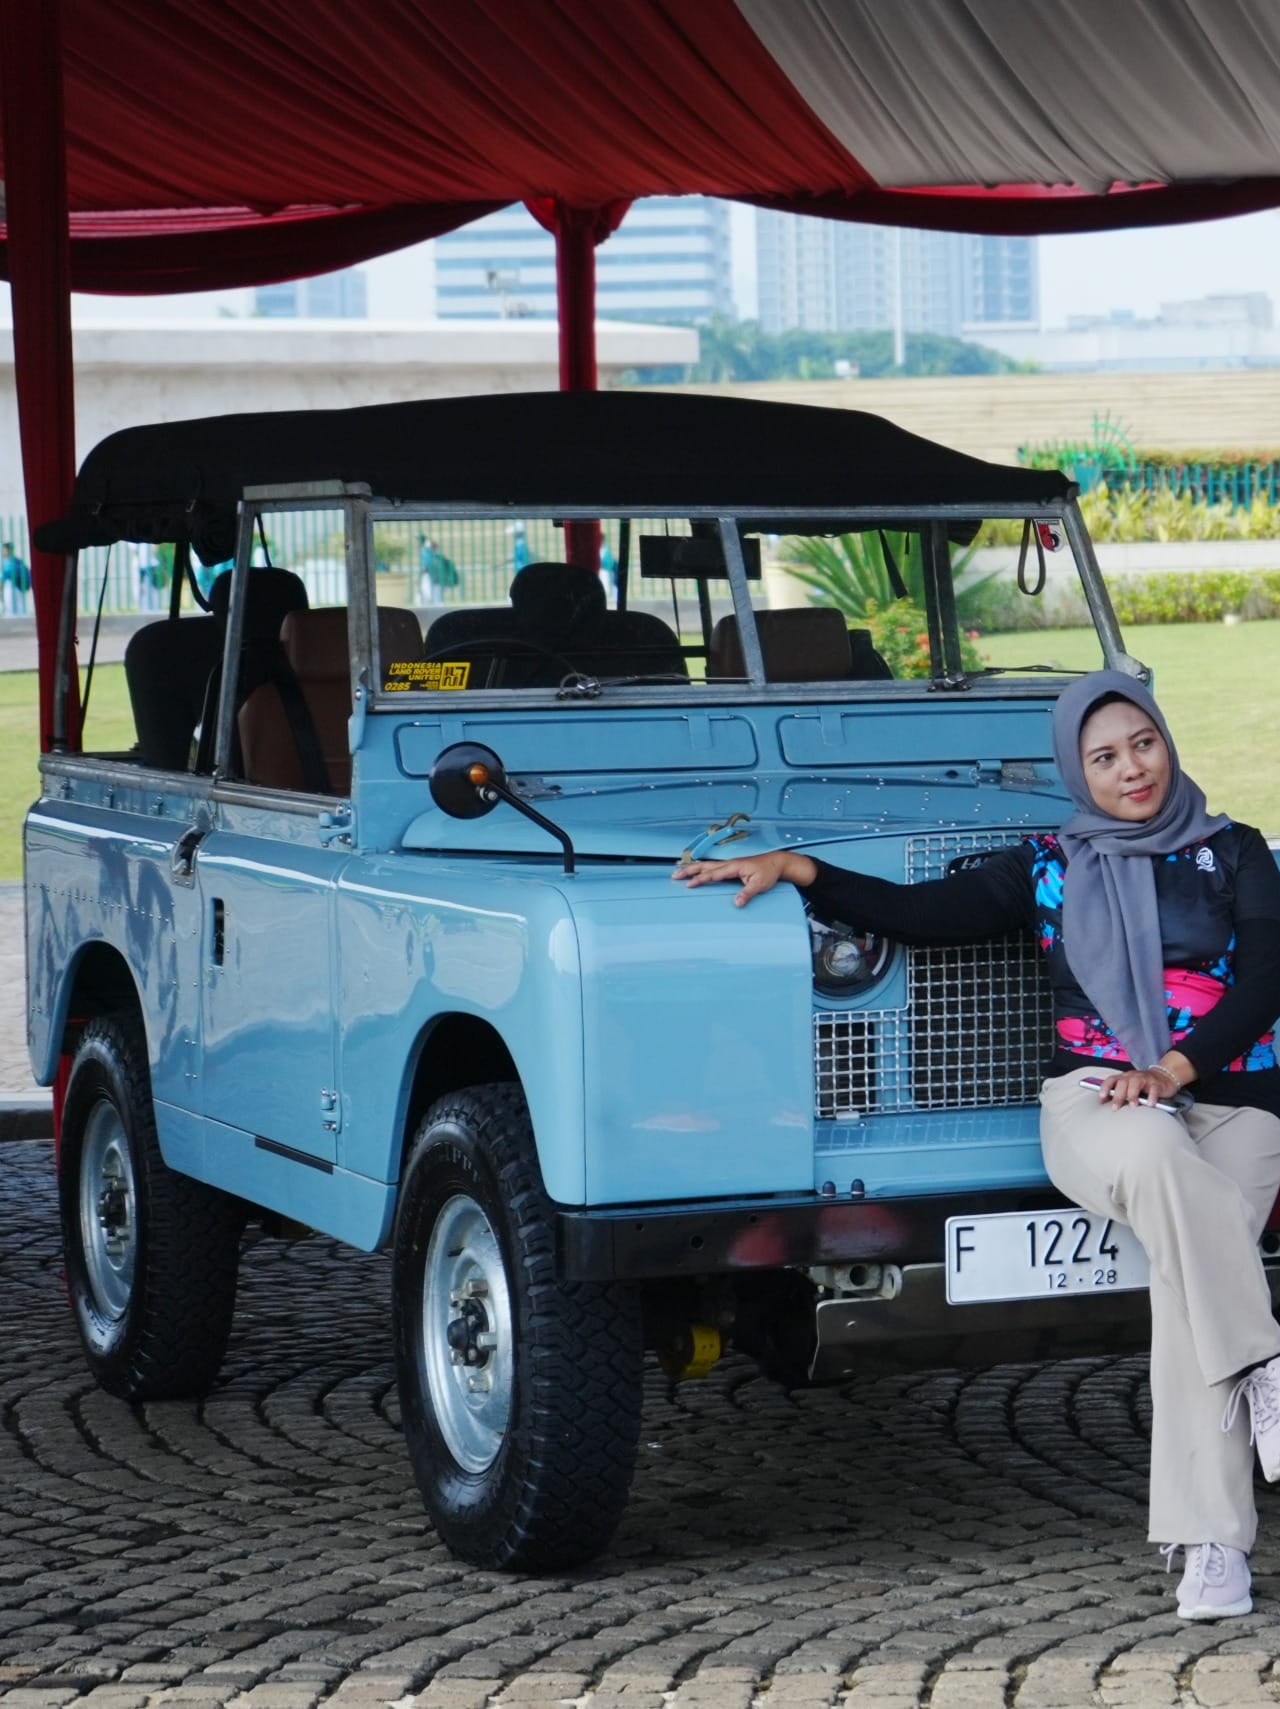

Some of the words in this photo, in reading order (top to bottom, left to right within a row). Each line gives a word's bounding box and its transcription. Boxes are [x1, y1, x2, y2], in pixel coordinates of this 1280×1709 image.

[956, 1226, 975, 1273] F
[1026, 1217, 1119, 1267] 1224
[1048, 1273, 1067, 1288] 12
[1094, 1269, 1117, 1285] 28
